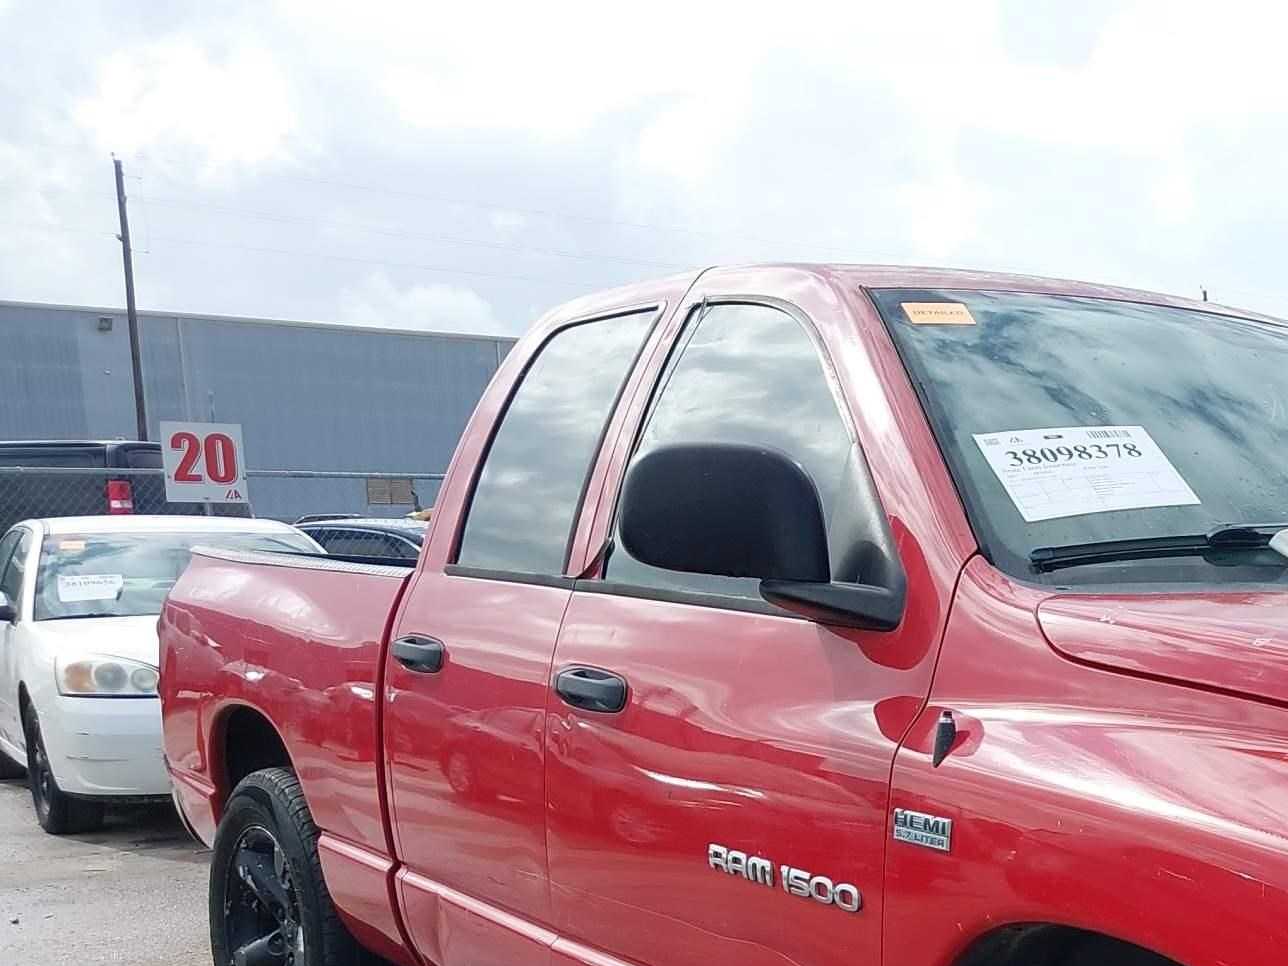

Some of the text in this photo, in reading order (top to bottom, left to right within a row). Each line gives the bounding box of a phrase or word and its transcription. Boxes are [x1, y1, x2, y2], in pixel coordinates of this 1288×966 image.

[170, 431, 238, 485] 20
[1004, 442, 1143, 468] 38098378
[894, 809, 948, 836] HEMI
[708, 843, 862, 913] RAM 1500
